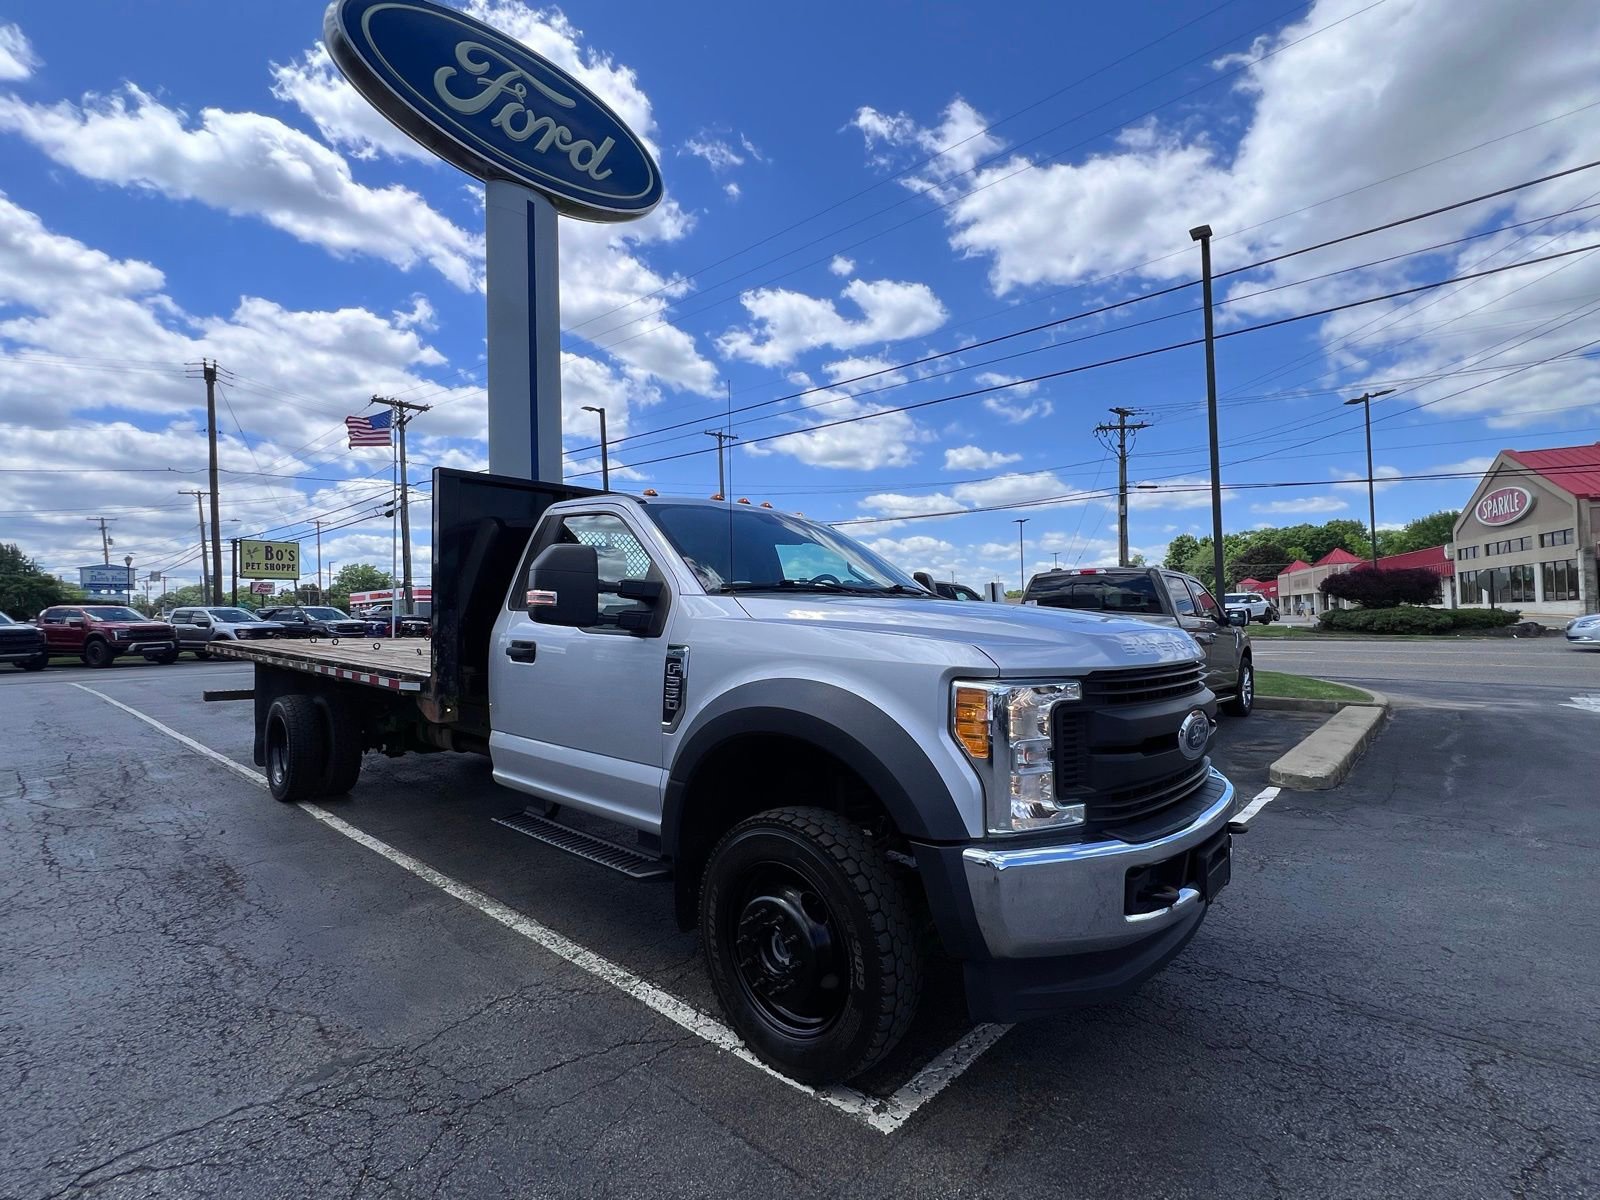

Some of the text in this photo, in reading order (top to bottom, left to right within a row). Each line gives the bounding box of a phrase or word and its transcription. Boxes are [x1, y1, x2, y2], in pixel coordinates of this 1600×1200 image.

[433, 41, 613, 181] Ford
[1482, 492, 1519, 519] SPARKLE
[245, 562, 296, 571] PET SHOPPE
